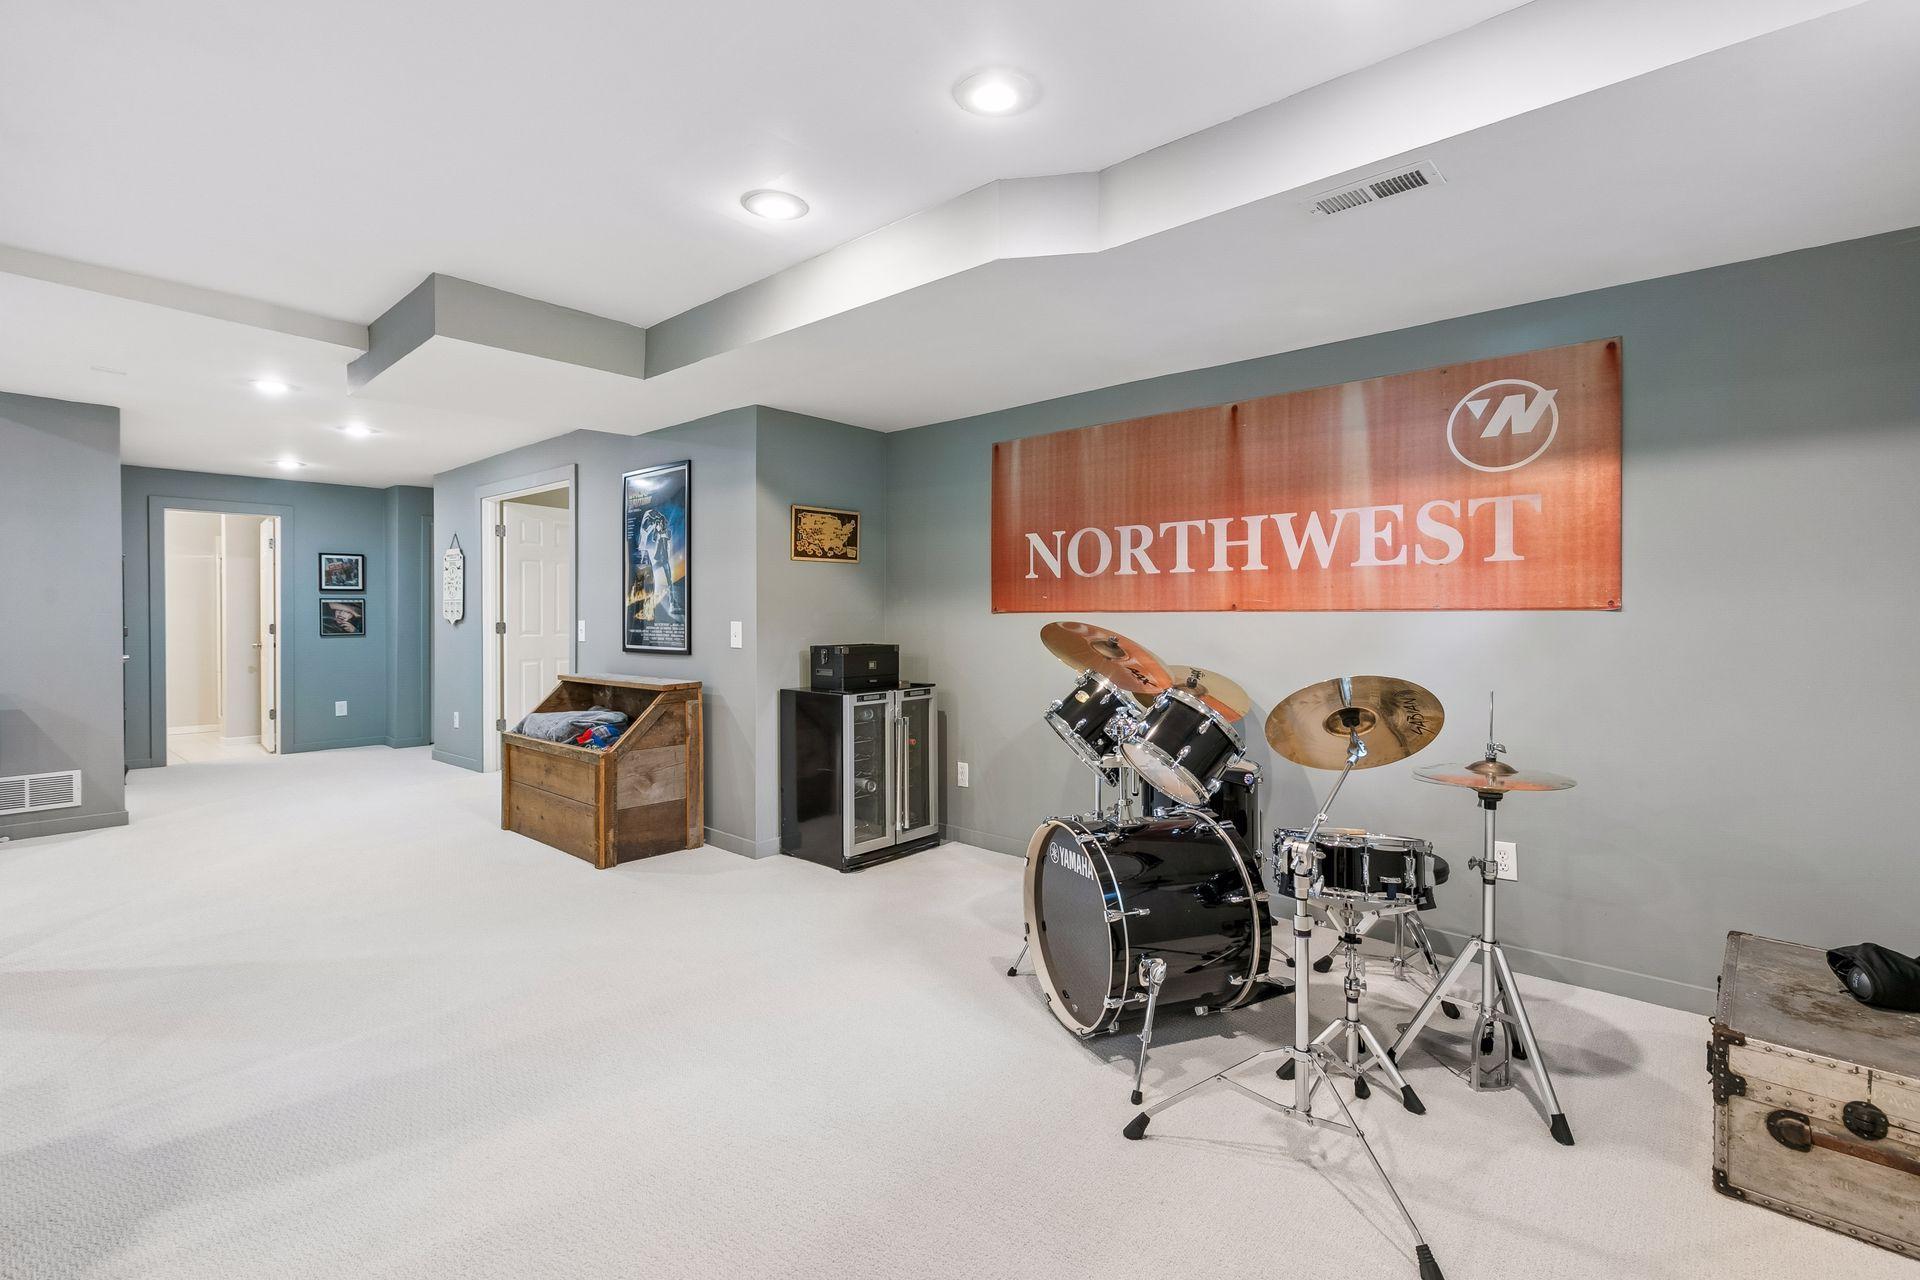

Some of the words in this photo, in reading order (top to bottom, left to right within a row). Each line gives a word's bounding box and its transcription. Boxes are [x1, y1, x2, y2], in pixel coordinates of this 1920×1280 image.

[1025, 495, 1542, 580] NORTHWEST
[1402, 697, 1435, 736] SABIAN
[1059, 845, 1095, 881] YAMAHA
